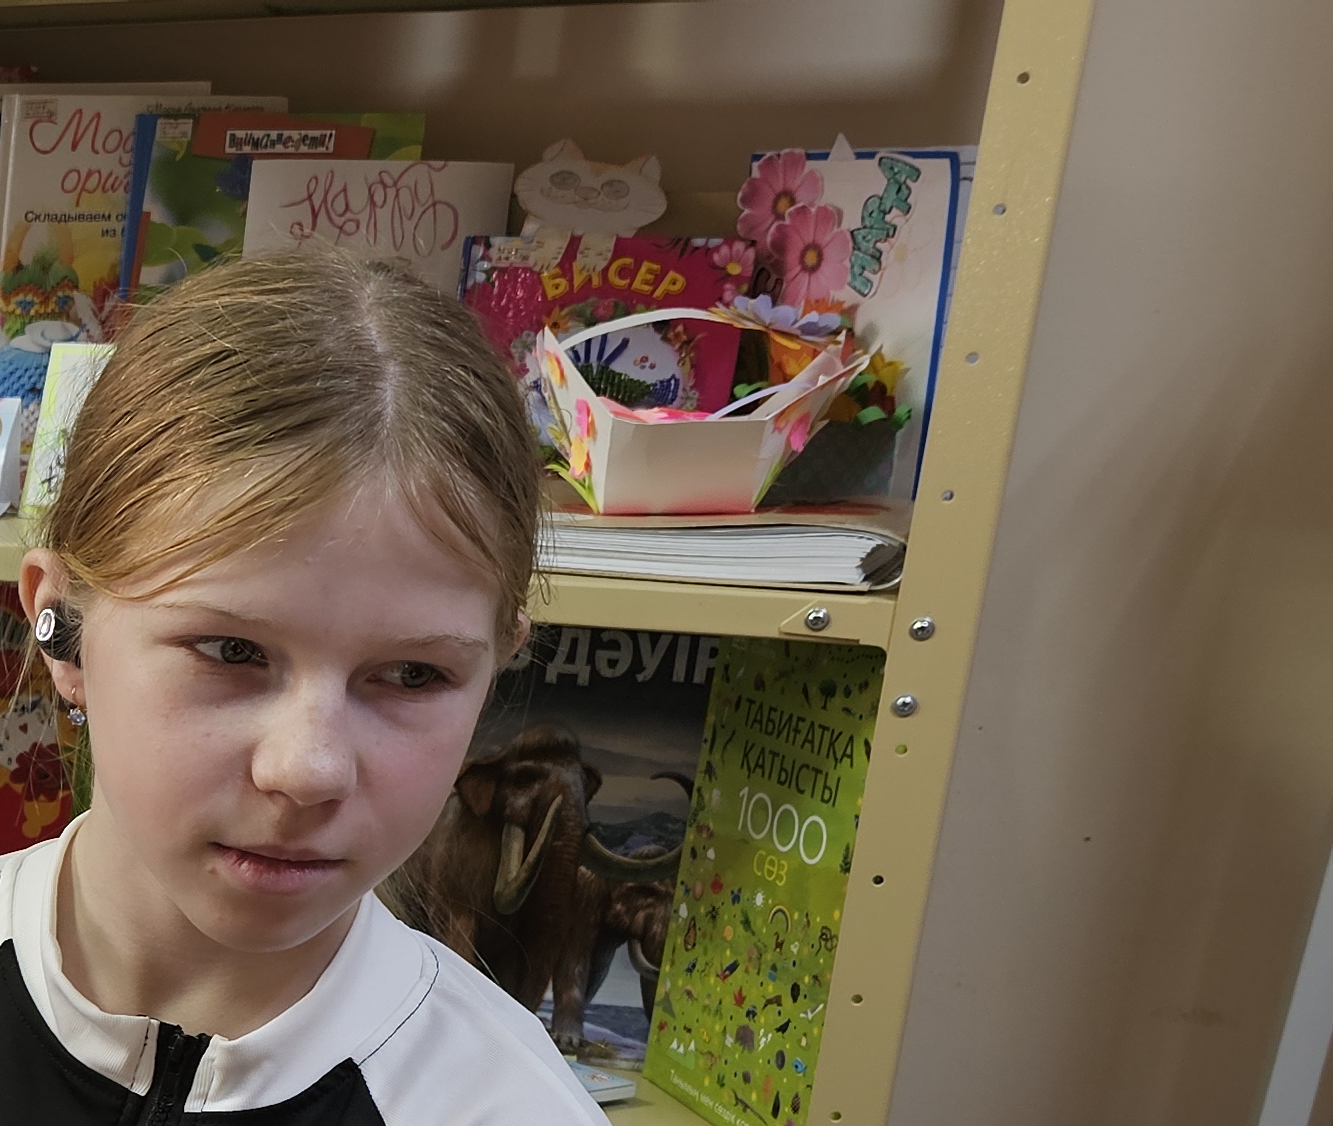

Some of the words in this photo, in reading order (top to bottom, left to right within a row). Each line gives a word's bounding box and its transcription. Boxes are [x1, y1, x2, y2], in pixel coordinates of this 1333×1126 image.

[25, 211, 111, 225] Складываем
[101, 228, 117, 238] из
[540, 257, 687, 301] БИСЕР
[744, 698, 855, 770] ТАБИҒАТҚА
[740, 740, 842, 808] ҚАТЫСТЫ
[738, 786, 827, 865] 1000
[753, 850, 788, 886] СӨЗ
